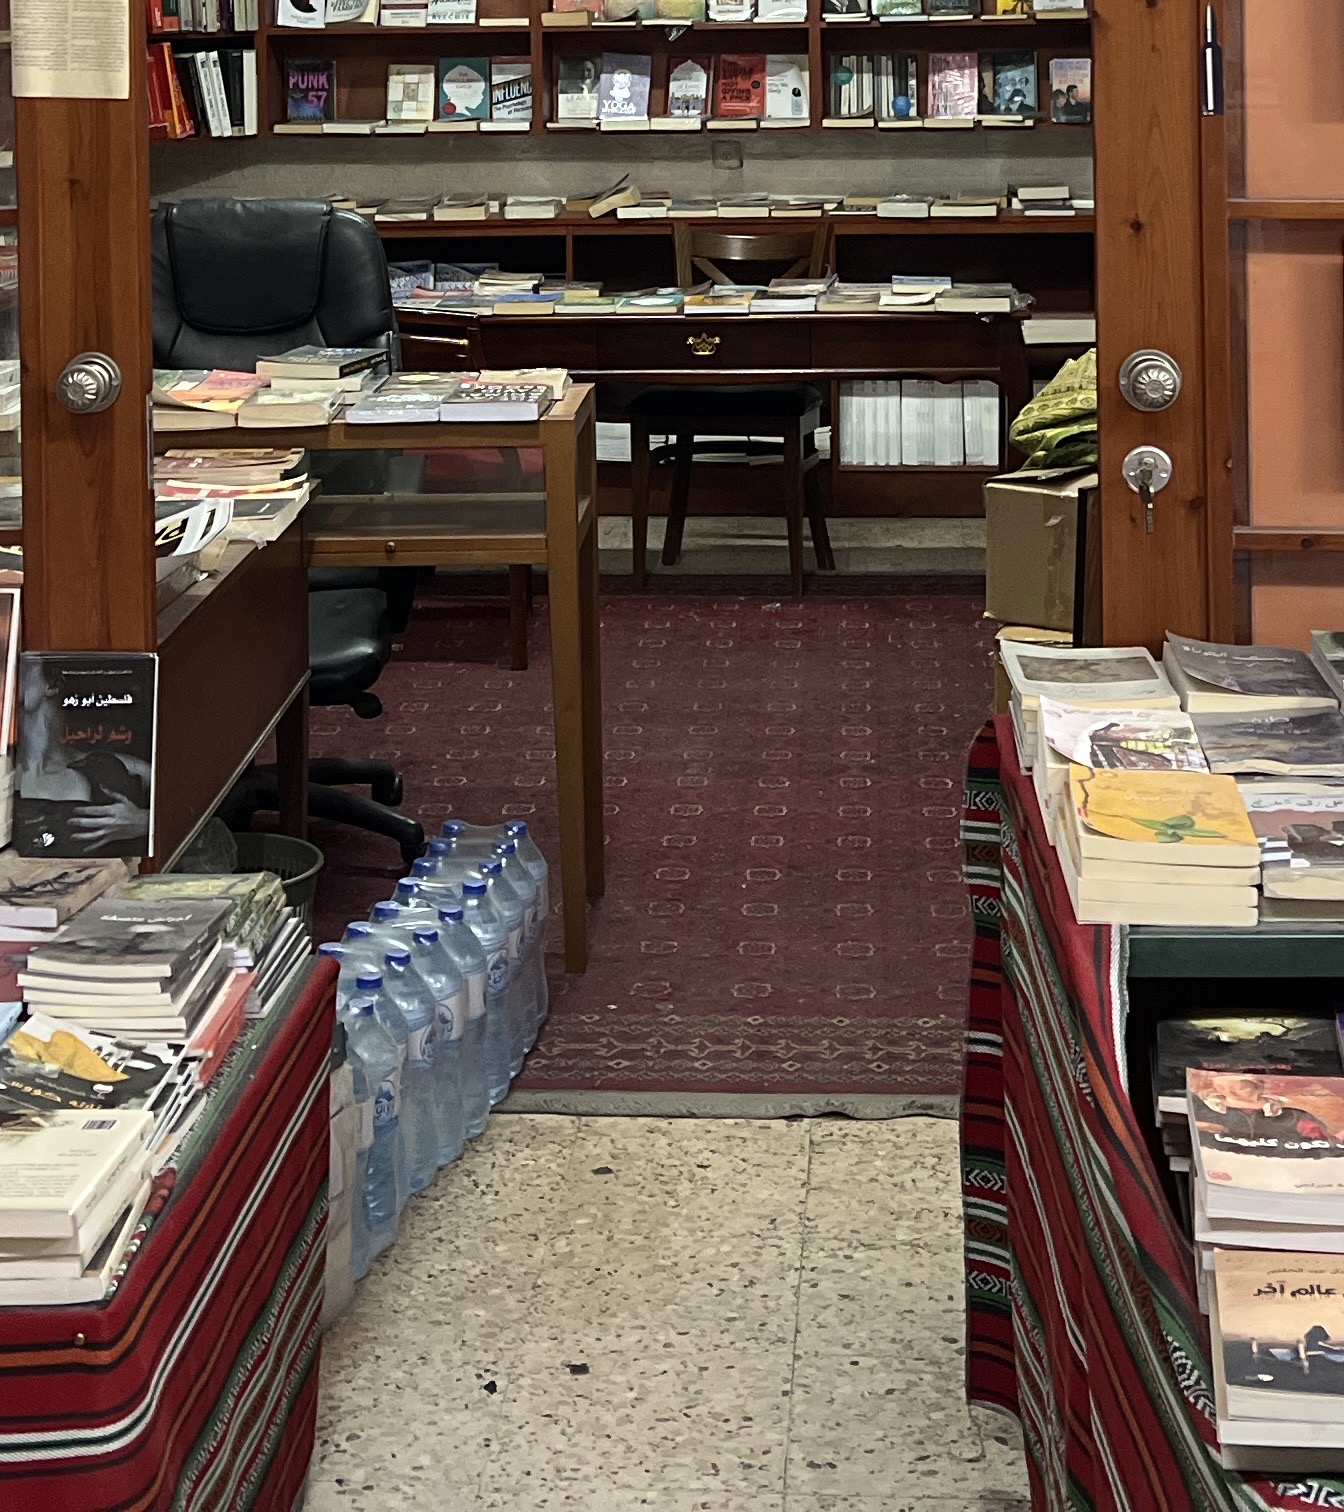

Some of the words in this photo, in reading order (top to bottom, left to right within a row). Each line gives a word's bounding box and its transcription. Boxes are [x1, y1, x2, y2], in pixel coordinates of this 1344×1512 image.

[289, 71, 330, 89] PUNK
[306, 90, 328, 109] 57
[62, 693, 80, 707] زهو
[80, 691, 95, 707] أبو
[95, 692, 133, 707] فلسطين
[58, 723, 103, 744] لراحيل
[107, 723, 133, 744] وشم
[1214, 1133, 1279, 1148] كليهما
[1253, 1279, 1287, 1298] آخر
[1290, 1283, 1337, 1298] عالم
